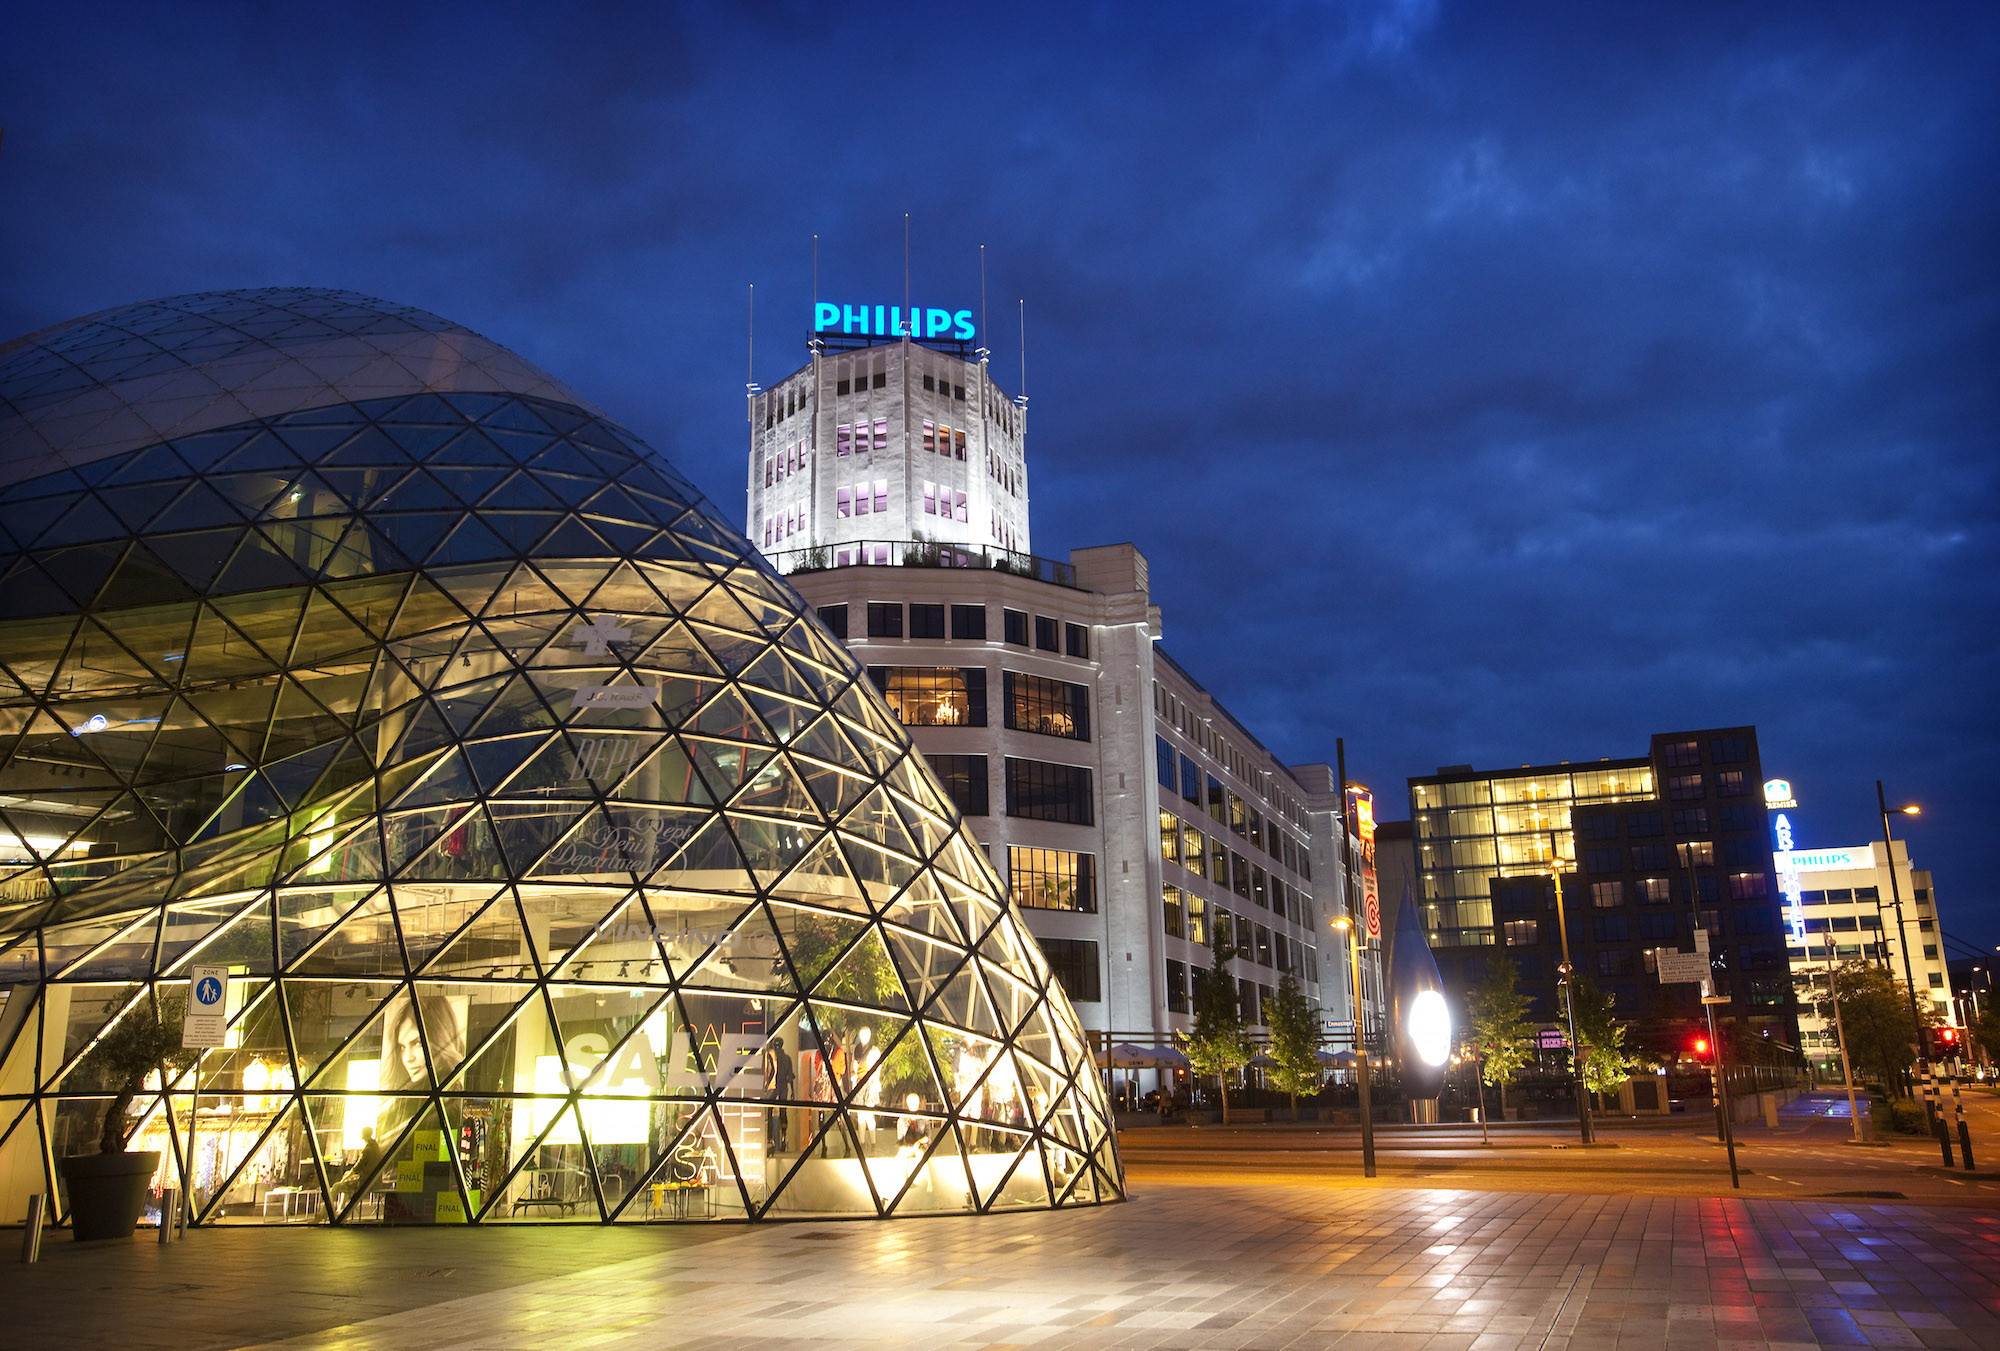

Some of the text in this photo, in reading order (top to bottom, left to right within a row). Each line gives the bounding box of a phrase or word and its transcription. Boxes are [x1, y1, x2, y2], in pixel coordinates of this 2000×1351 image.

[815, 302, 976, 341] PHILIPS
[1792, 853, 1850, 866] PHILIPS
[594, 922, 742, 948] VINGINO
[559, 1032, 768, 1091] SALE
[415, 1143, 438, 1152] FINAL
[399, 1173, 421, 1182] FINAL
[438, 1204, 461, 1213] FINAL
